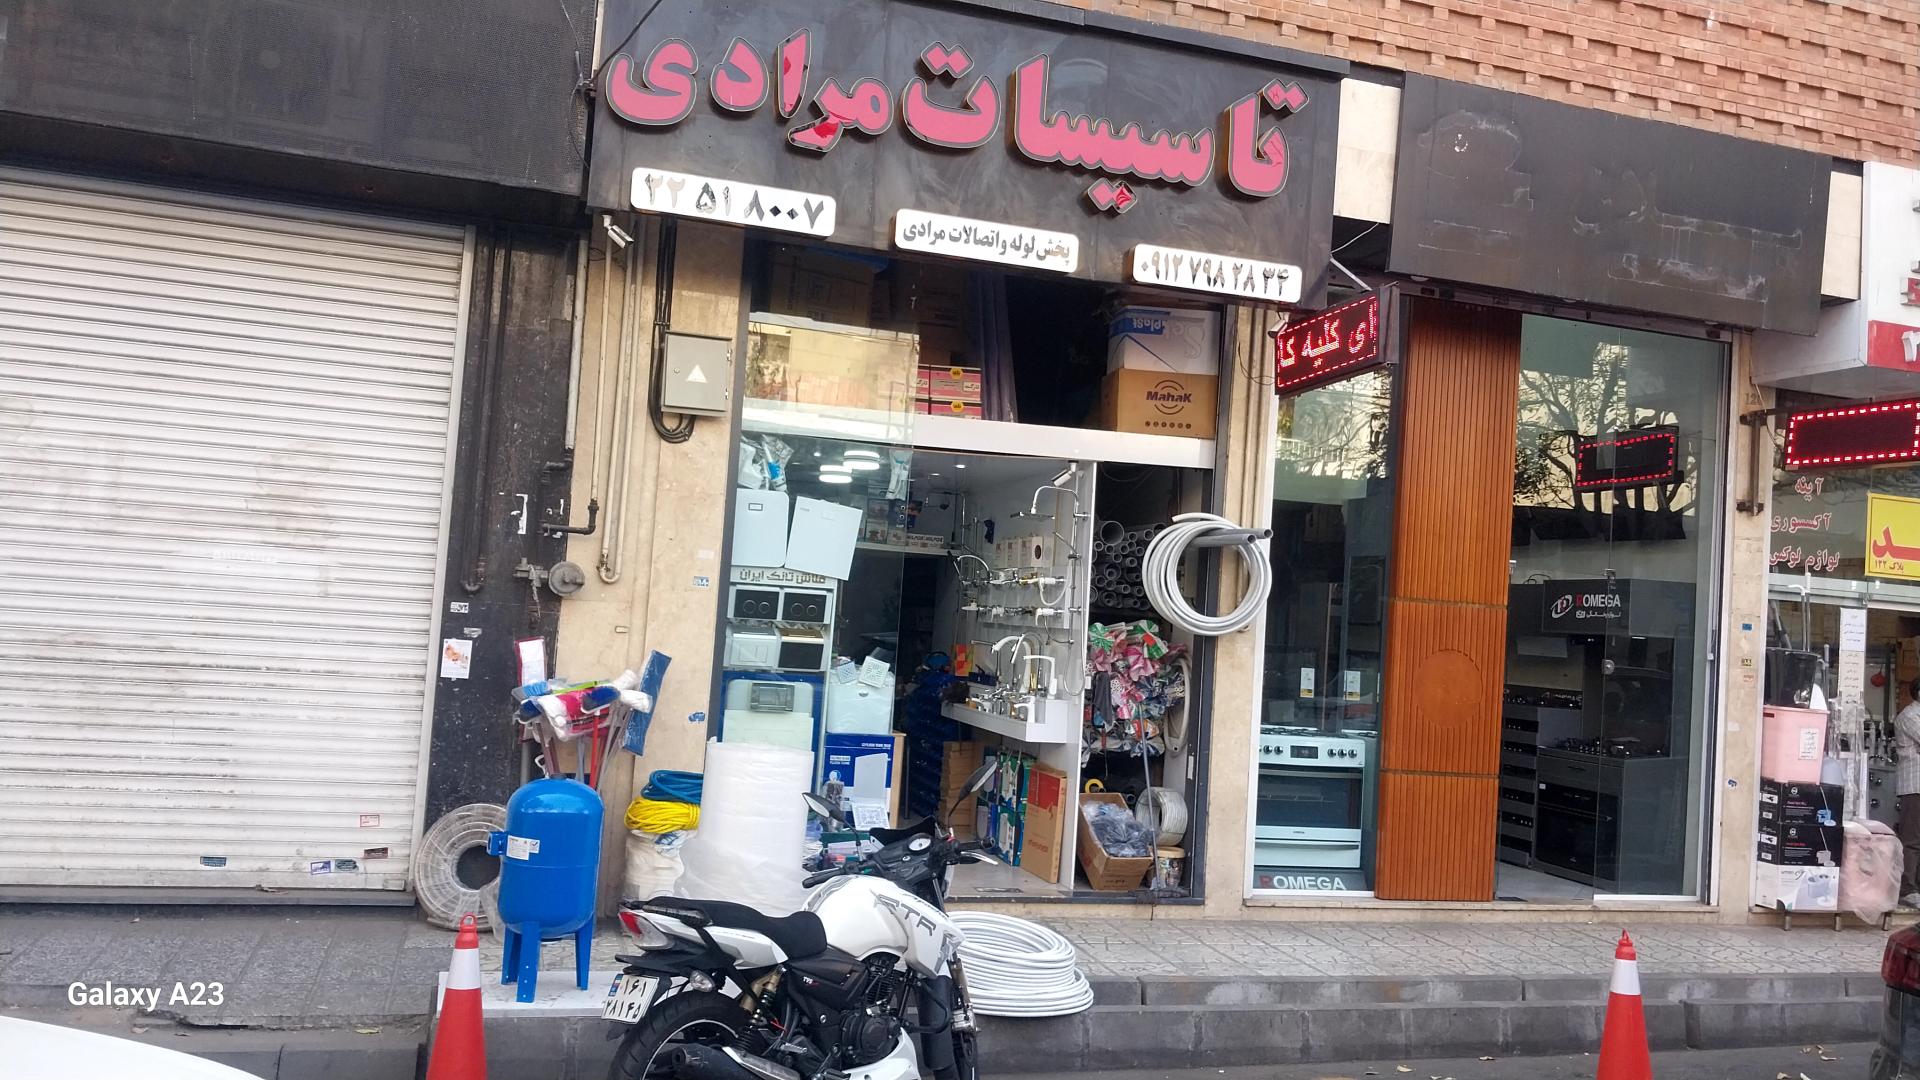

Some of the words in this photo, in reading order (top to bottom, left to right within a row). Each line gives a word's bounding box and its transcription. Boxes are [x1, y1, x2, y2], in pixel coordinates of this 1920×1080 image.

[606, 27, 895, 152] مرادی
[903, 220, 946, 246] مرادی
[1009, 233, 1036, 259] لوله
[1036, 238, 1070, 266] پخش
[1795, 476, 1824, 502] آینه
[1804, 548, 1841, 573] لوازم
[740, 568, 765, 582] ایران
[767, 571, 794, 582] تانک
[1575, 593, 1621, 608] ROMEGA
[1259, 875, 1347, 891] ROMEGA
